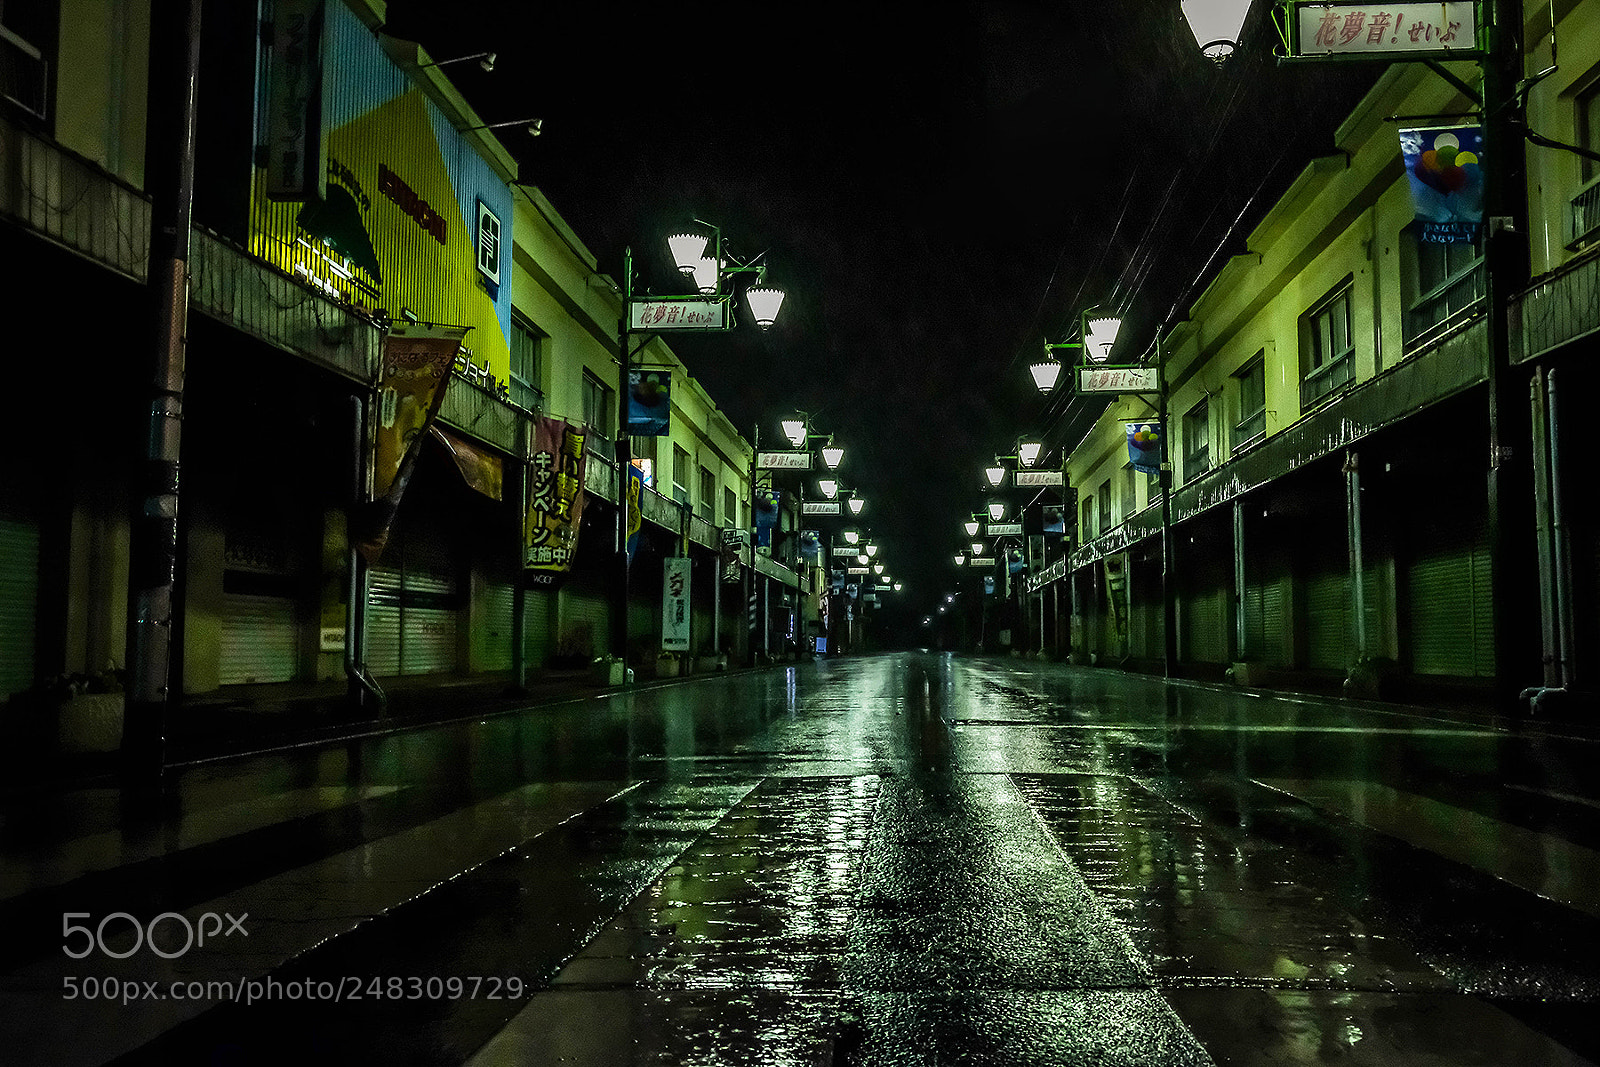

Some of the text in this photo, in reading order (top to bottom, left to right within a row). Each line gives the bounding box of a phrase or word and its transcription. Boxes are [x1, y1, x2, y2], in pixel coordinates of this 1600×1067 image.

[532, 452, 552, 547] キャンペーン
[526, 547, 573, 567] 実施中!
